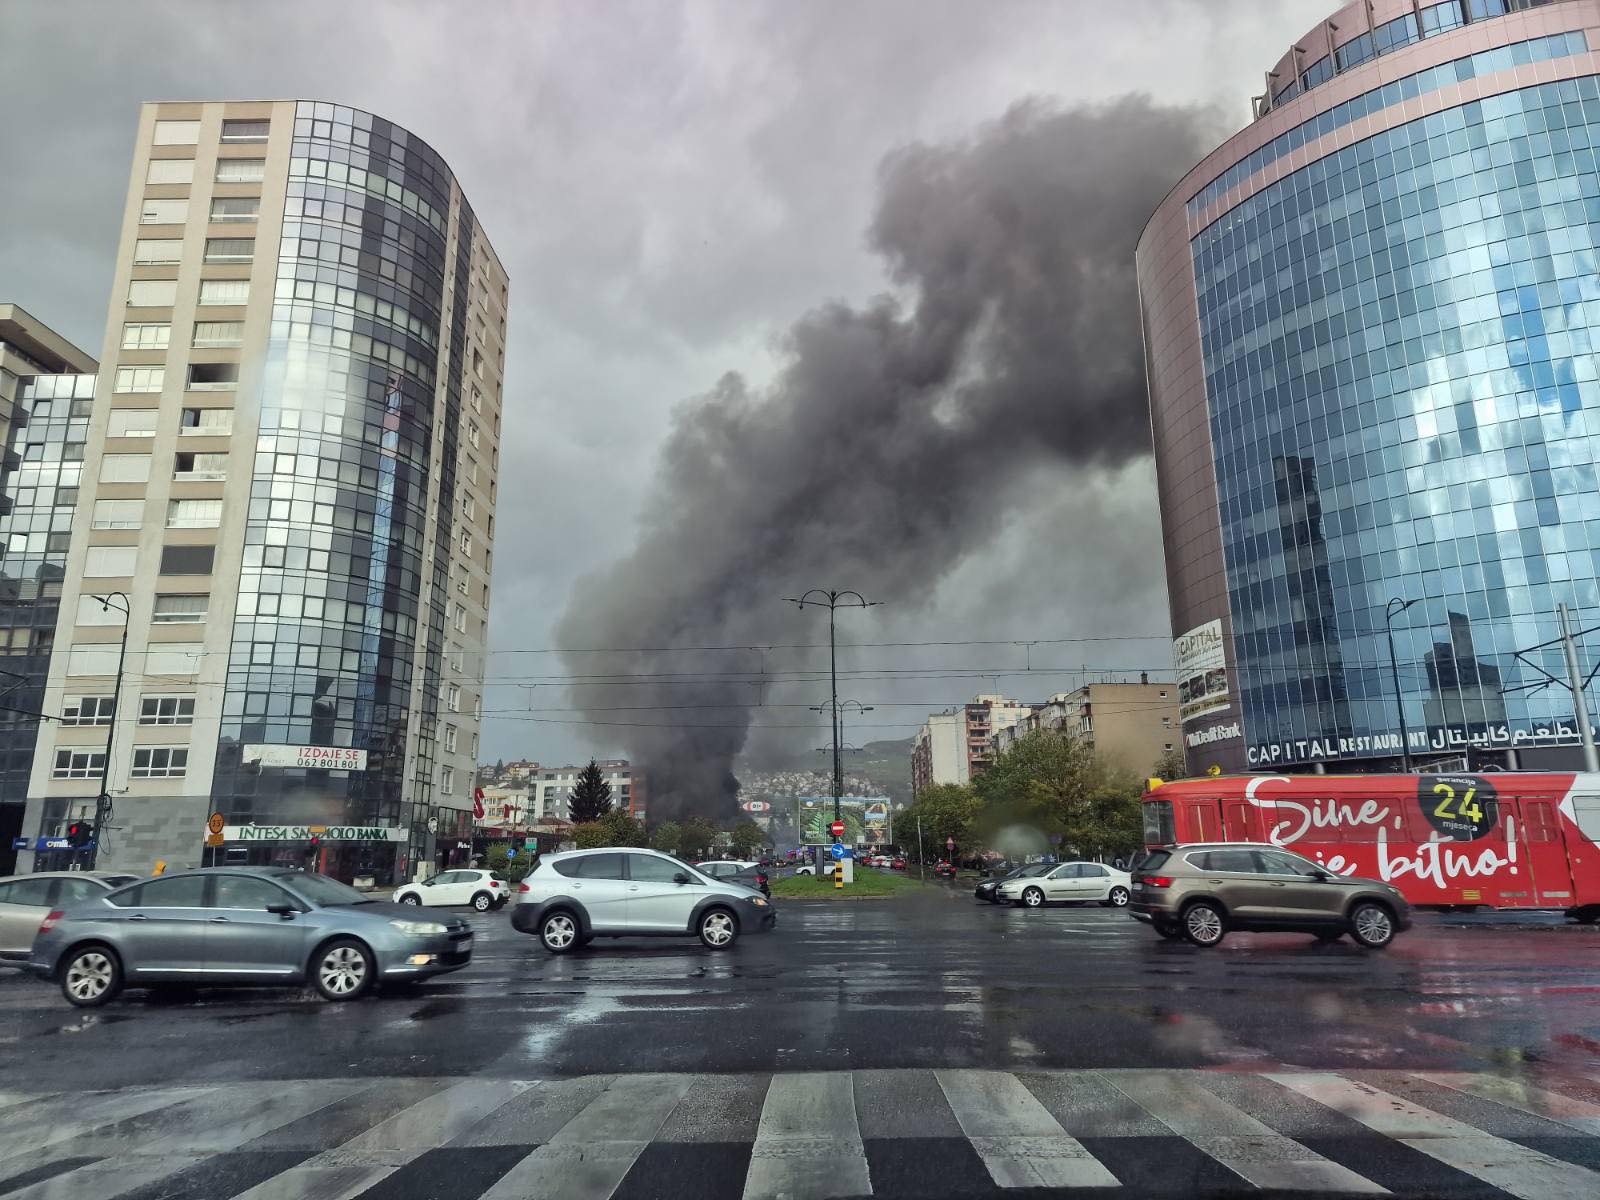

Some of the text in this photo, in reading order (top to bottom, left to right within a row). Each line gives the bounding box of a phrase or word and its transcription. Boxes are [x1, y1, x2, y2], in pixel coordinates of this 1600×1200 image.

[1180, 627, 1222, 655] CAPITAL
[299, 747, 359, 760] IZDAJE SE
[1248, 739, 1338, 763] CAPITAL
[297, 758, 317, 767] 062
[320, 758, 339, 768] 801
[341, 760, 358, 769] 801
[1433, 783, 1483, 823] 24
[239, 826, 287, 839] INTESA
[356, 828, 388, 840] BANKA
[1377, 815, 1518, 889] bitno!
